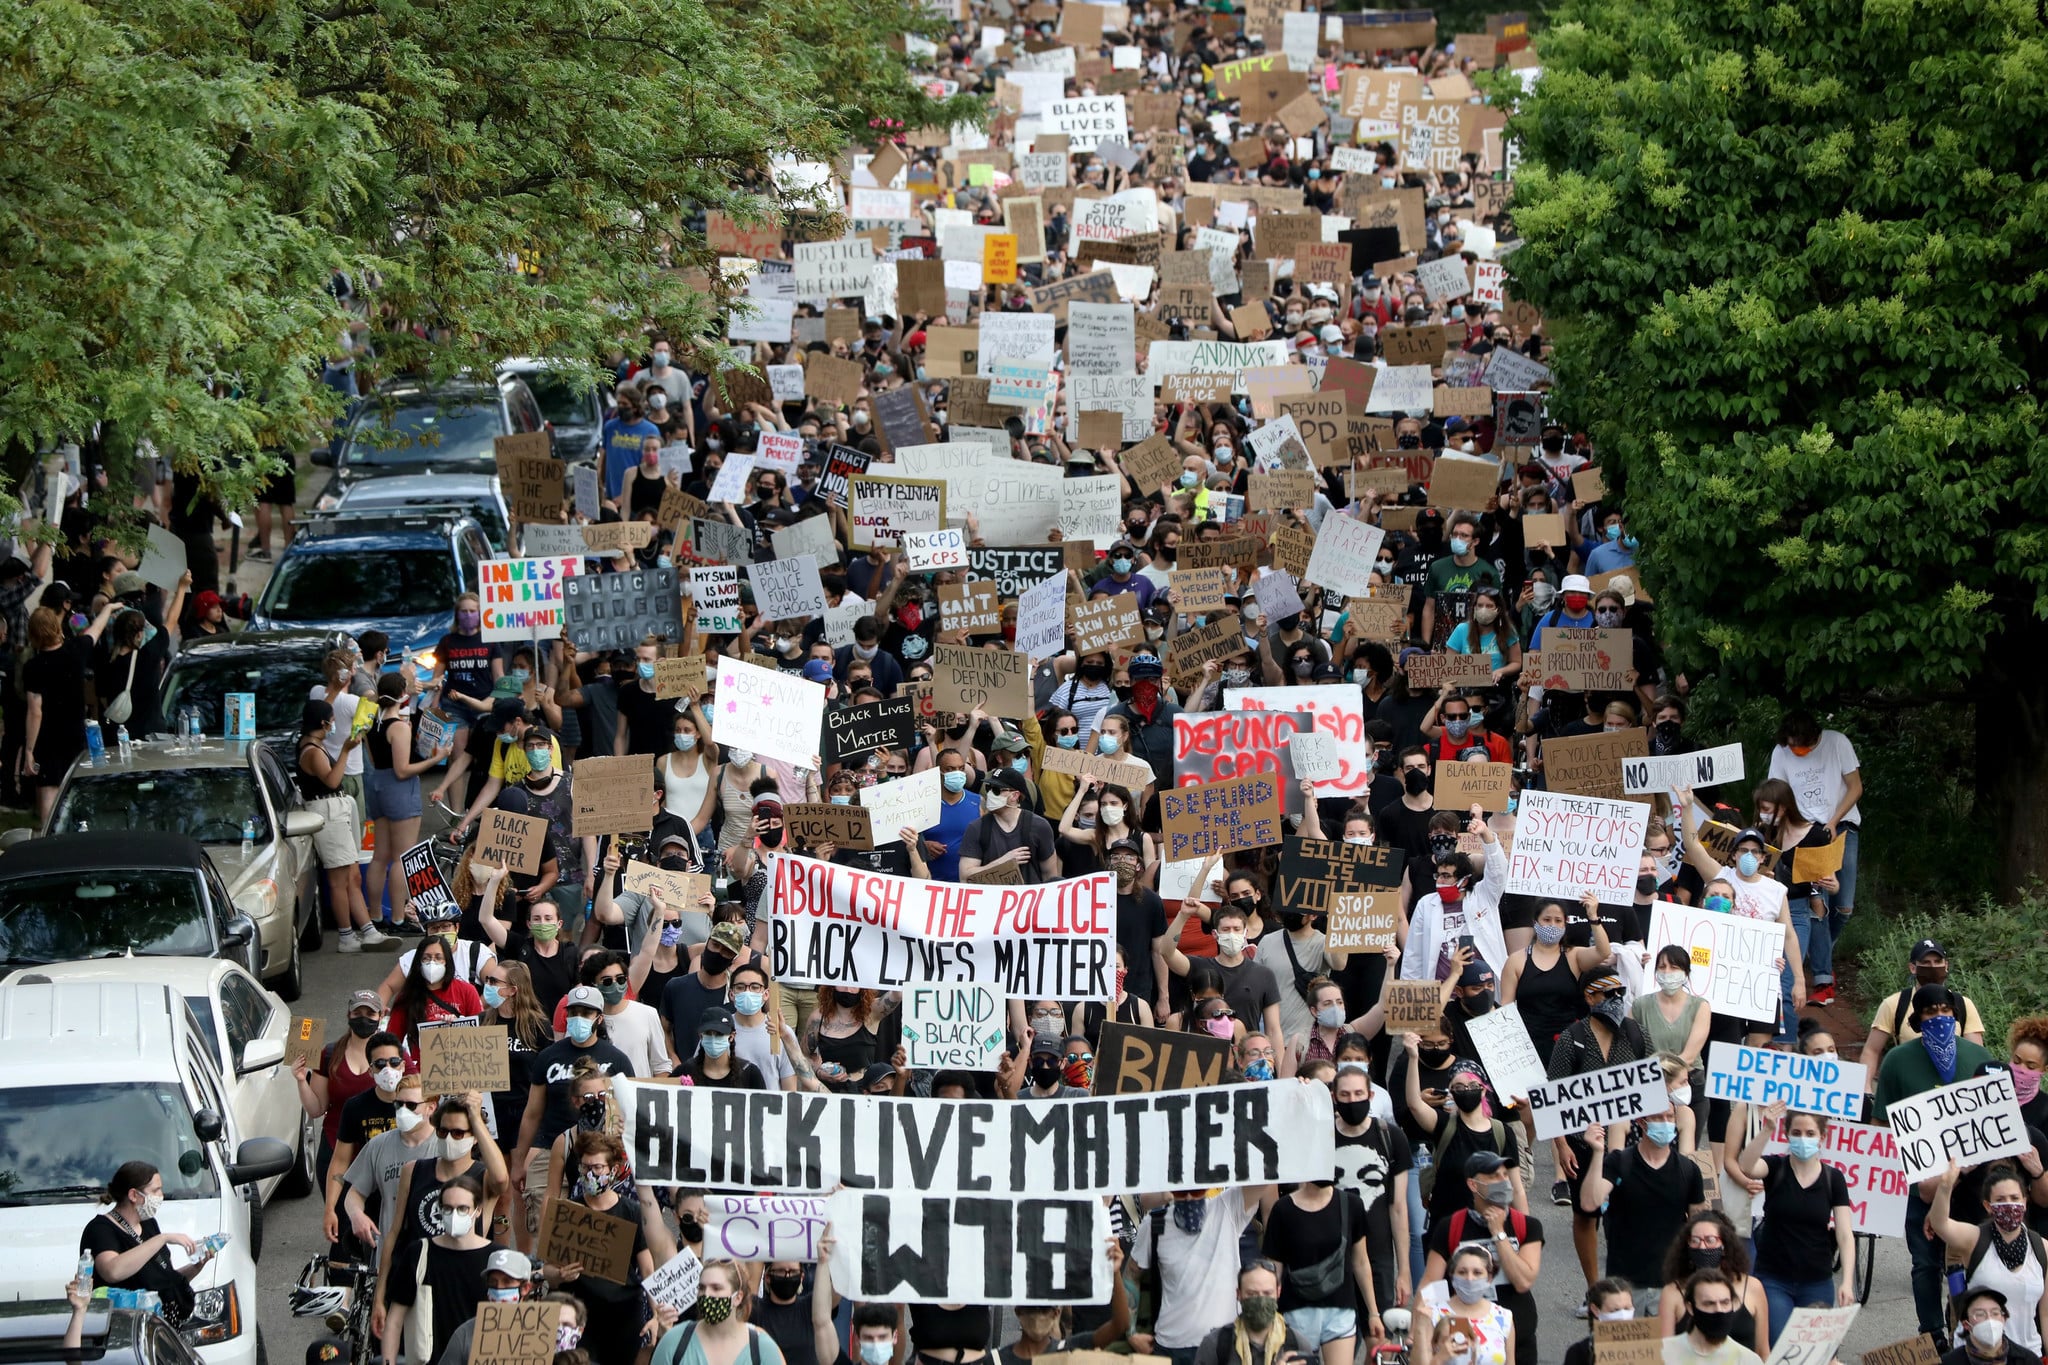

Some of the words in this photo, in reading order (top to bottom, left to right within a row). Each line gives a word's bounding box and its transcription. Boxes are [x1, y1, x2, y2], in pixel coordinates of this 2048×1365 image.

[1053, 102, 1116, 114] BLACK
[1402, 105, 1460, 125] BLACK
[1060, 119, 1115, 130] LIVES
[1024, 154, 1061, 167] DEFUND
[1025, 169, 1060, 184] POLICE
[1092, 202, 1126, 214] STOP
[1086, 214, 1125, 228] POLICE
[799, 241, 870, 262] JUSTICE
[1310, 247, 1348, 261] RACIST
[819, 262, 848, 274] FOR
[1418, 264, 1445, 279] BLACK
[796, 275, 874, 294] BREONNA
[1034, 272, 1116, 304] DEFUND
[1427, 272, 1453, 286] LIVES
[1434, 280, 1464, 296] MATTER
[1180, 290, 1192, 304] FU
[1160, 304, 1209, 320] POLICE
[1398, 339, 1432, 354] BLM
[1074, 378, 1147, 400] BLACK
[1168, 375, 1213, 390] DEFUND
[1215, 375, 1234, 388] THE
[1175, 389, 1216, 401] POLICE
[1280, 398, 1343, 418] DEFUND
[762, 436, 799, 449] DEFUND
[766, 448, 795, 461] POLICE
[833, 452, 867, 468] ENACT
[1136, 447, 1172, 474] JUSTICE
[519, 459, 562, 481] DEFUND
[1150, 464, 1183, 484] PEACE
[520, 482, 542, 497] THE
[854, 482, 893, 500] HAPPY
[516, 501, 564, 520] POLICE!
[854, 516, 890, 527] BLACK
[909, 536, 926, 549] No
[929, 531, 960, 548] CPD
[756, 559, 800, 576] DEFUND
[912, 555, 930, 568] In
[932, 552, 959, 565] CPS
[1191, 552, 1253, 569] BRUTALITY
[482, 558, 578, 583] INVEST
[695, 571, 708, 582] MY
[710, 571, 736, 582] SKIN
[994, 570, 1020, 579] FOR
[1172, 572, 1192, 583] HOW
[1196, 570, 1220, 582] MANY
[486, 584, 513, 603] IN
[522, 582, 562, 602] BLAC
[567, 574, 671, 596] BLACK
[705, 584, 716, 597] IS
[717, 584, 738, 596] NOT
[760, 574, 804, 592] POLICE
[767, 588, 798, 603] FUND
[571, 595, 670, 623] LIVES
[770, 596, 822, 619] SCHOOLS
[1075, 598, 1117, 618] BLACK
[942, 614, 999, 631] BREATHE
[1075, 616, 1106, 637] SKIN
[1108, 614, 1118, 626] IS
[1120, 612, 1140, 627] NOT
[1566, 628, 1599, 641] JUSTICE
[1579, 642, 1598, 652] FOR
[935, 646, 1021, 673] DEMILITARIZE
[1408, 656, 1449, 668] DEFUND
[1452, 655, 1474, 666] AND
[1548, 652, 1600, 671] BREONNA
[952, 669, 1007, 688] DEFUND
[1470, 664, 1490, 676] THE
[1581, 672, 1624, 690] TAYLOR
[829, 710, 872, 730] BLACK
[878, 702, 911, 717] LIVES
[420, 718, 442, 736] Welch's
[836, 728, 898, 750] MATTER
[1173, 712, 1299, 762] DEFUND
[1549, 749, 1560, 764] IF
[1612, 740, 1646, 758] EVER
[1080, 757, 1108, 778] LIVES
[1108, 762, 1150, 788] MATTER
[1446, 764, 1477, 778] BLACK
[1481, 765, 1506, 778] LIVES
[1549, 763, 1604, 782] WONDERED
[1626, 762, 1648, 788] NO
[1696, 756, 1714, 782] NO
[1461, 781, 1503, 791] MATTER!
[1166, 780, 1274, 820] DEFUND
[1561, 799, 1604, 815] TREAT
[1608, 804, 1634, 818] THE
[492, 814, 530, 836] BLACK
[1200, 810, 1241, 830] THE
[1524, 809, 1642, 849] SYMPTOMS
[790, 820, 840, 839] FUCK
[848, 821, 866, 840] 12
[1172, 818, 1275, 860] POLICE
[495, 832, 523, 848] LIVES
[1516, 836, 1553, 855] WHEN
[1559, 840, 1588, 857] YOU
[1591, 844, 1618, 860] CAN
[481, 846, 525, 868] MATTER
[1300, 839, 1390, 868] SILENCE
[1324, 861, 1354, 882] IS
[1511, 855, 1540, 879] FIX
[1543, 866, 1554, 874] THE
[1558, 860, 1633, 890] DISEASE
[772, 857, 905, 931] ABOLISH
[924, 884, 984, 939] THE
[992, 876, 1110, 935] POLICE
[1335, 896, 1374, 914] STOP
[1330, 914, 1394, 930] LYNCHING
[1329, 932, 1363, 948] BLACK
[1718, 922, 1785, 969] JUSTICE
[772, 919, 862, 982] BLACK
[878, 930, 976, 987] LIVES
[993, 938, 1109, 996] MATTER
[1692, 957, 1710, 966] NOW
[1388, 986, 1440, 1004] ABOLISH
[1712, 963, 1779, 1013] PEACE
[914, 986, 995, 1024] FUND
[430, 1033, 503, 1051] AGAINST
[925, 1022, 982, 1046] BLACK
[435, 1052, 492, 1064] RACISM
[1114, 1034, 1223, 1098] BLM
[1736, 1048, 1840, 1085] DEFUND
[428, 1062, 502, 1078] AGAINST
[422, 1080, 456, 1092] POLICE
[462, 1080, 509, 1090] VIOLENCE
[1528, 1078, 1593, 1110] BLACK
[1600, 1061, 1662, 1094] LIVES
[1711, 1072, 1753, 1101] THE
[1762, 1078, 1861, 1118] POLICE
[1560, 1093, 1643, 1130] MATTER
[1891, 1106, 1922, 1138] NO
[1926, 1078, 2012, 1122] JUSTICE
[634, 1087, 828, 1189] BLACK
[839, 1098, 995, 1191] LIVE
[1010, 1086, 1280, 1192] MATTER
[1900, 1137, 1936, 1174] NO
[1940, 1114, 2017, 1161] PEACE
[724, 1198, 825, 1216] DEFUND
[555, 1203, 620, 1238] BLACK
[551, 1223, 610, 1254] LIVES
[481, 1306, 550, 1332] BLACK
[479, 1332, 550, 1356] LIVES
[1600, 1348, 1655, 1362] ABOLISH
